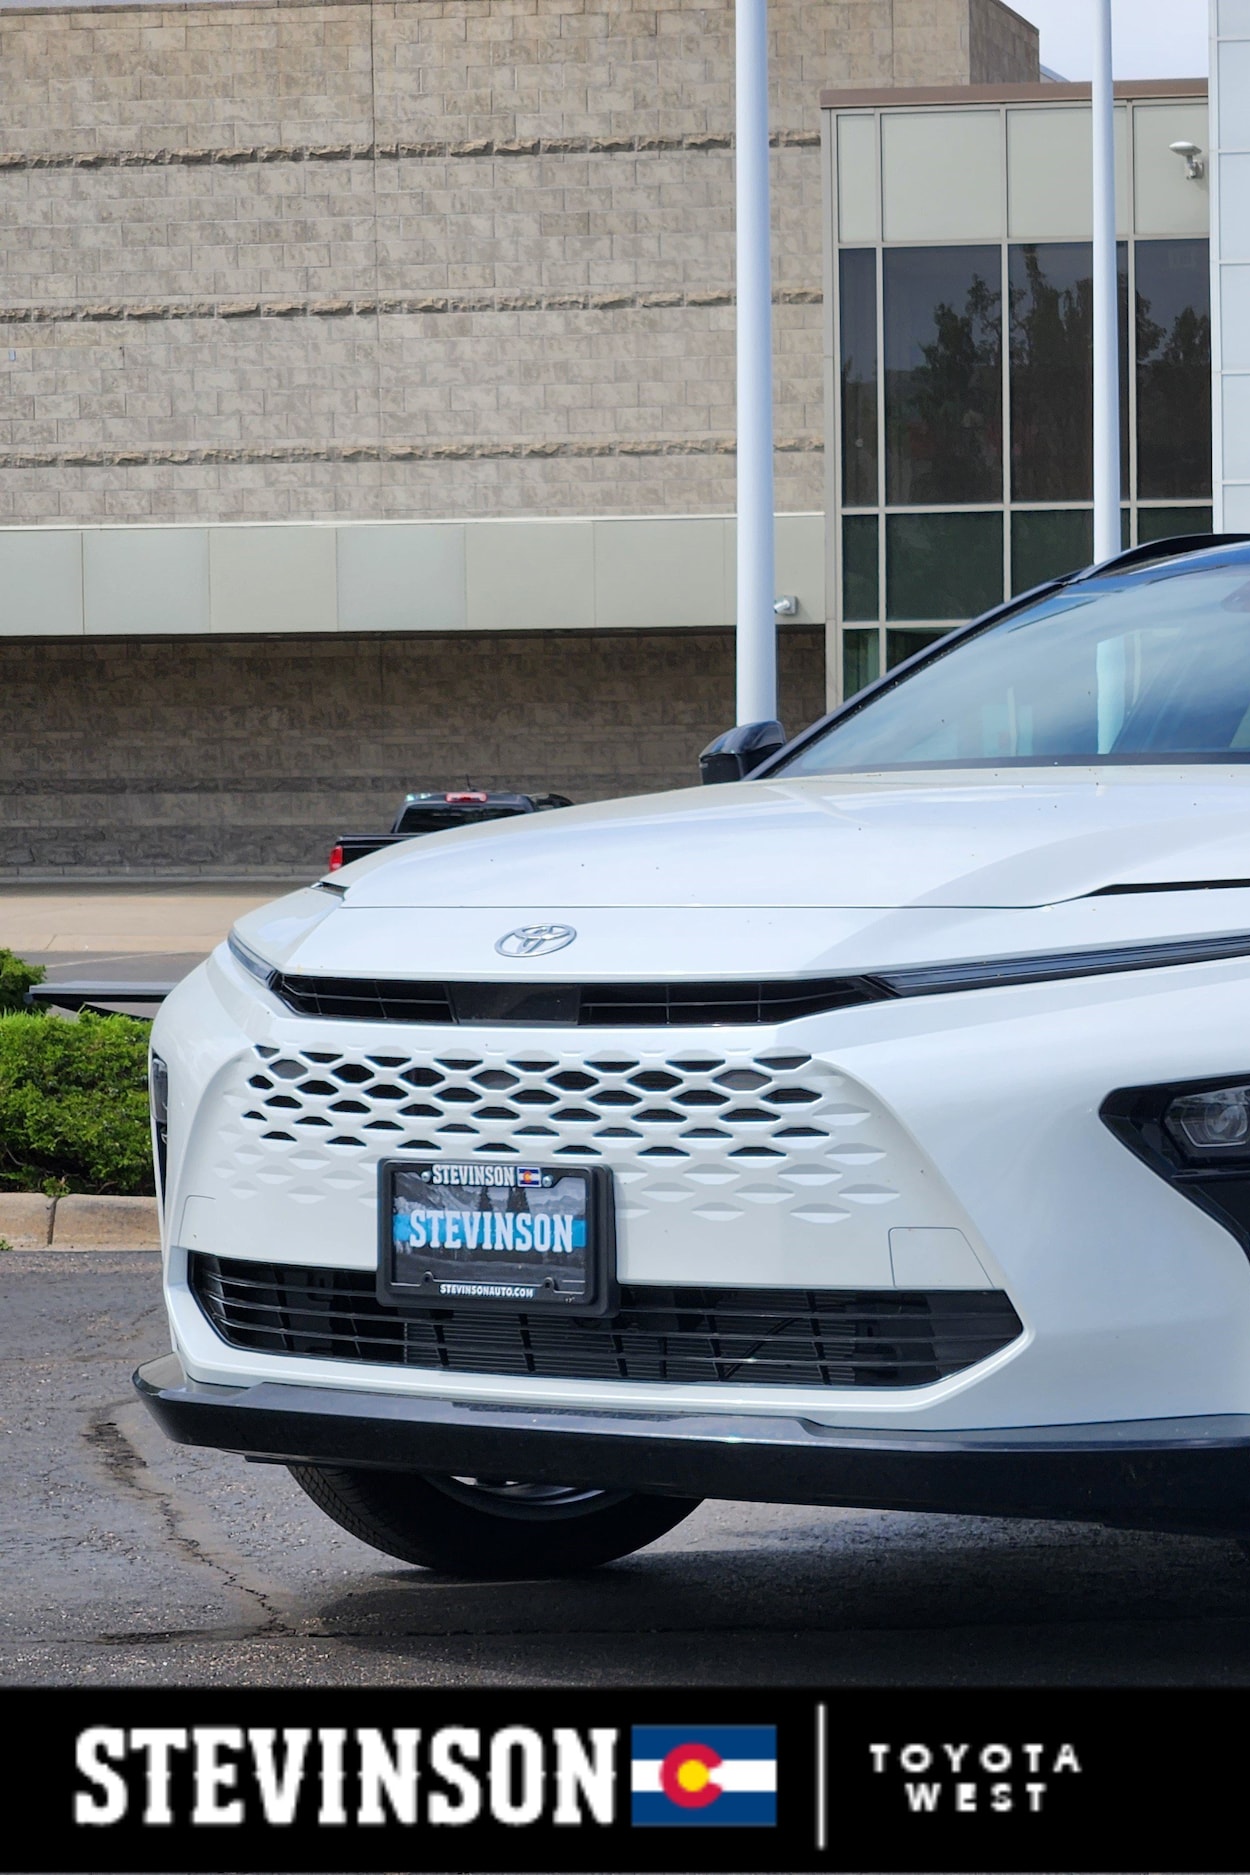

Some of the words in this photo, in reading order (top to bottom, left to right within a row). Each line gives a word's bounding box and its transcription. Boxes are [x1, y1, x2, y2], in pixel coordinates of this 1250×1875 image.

[432, 1164, 515, 1187] STEVINSON
[409, 1210, 573, 1253] STEVINSON
[440, 1283, 534, 1298] STEVINSONAUTO.COM
